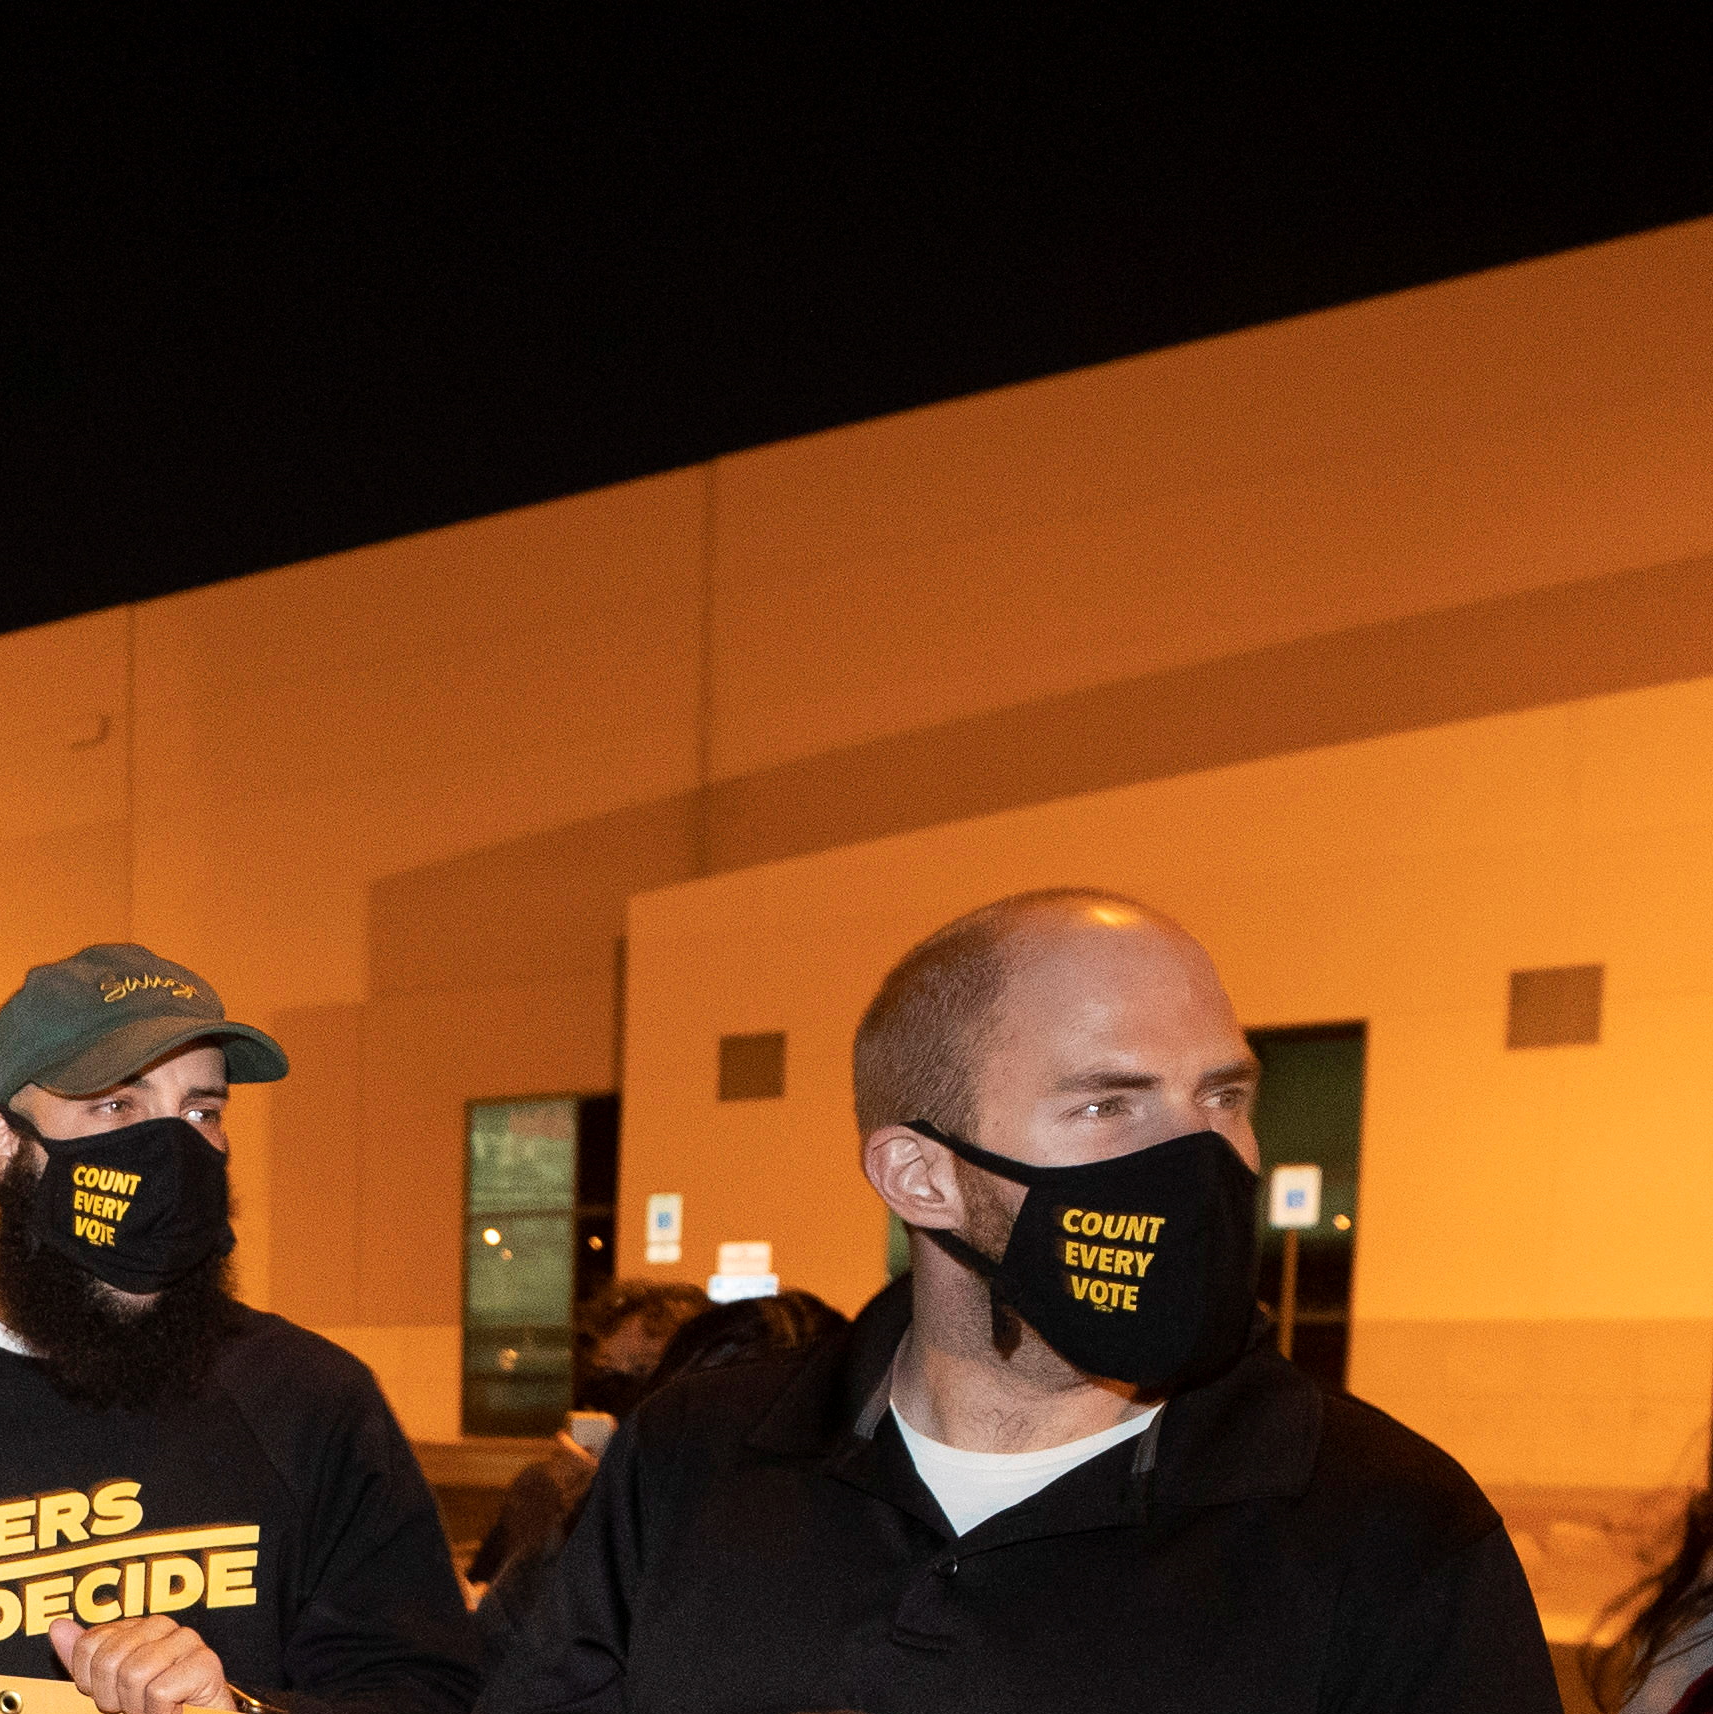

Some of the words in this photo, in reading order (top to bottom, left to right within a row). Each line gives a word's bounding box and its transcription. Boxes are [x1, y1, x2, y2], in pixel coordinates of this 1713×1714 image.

[73, 1165, 142, 1196] COUNT
[74, 1189, 131, 1222] EVERY
[75, 1215, 115, 1246] VOTE
[1062, 1208, 1166, 1244] COUNT
[1065, 1241, 1155, 1278] EVERY
[1071, 1275, 1140, 1312] VOTE
